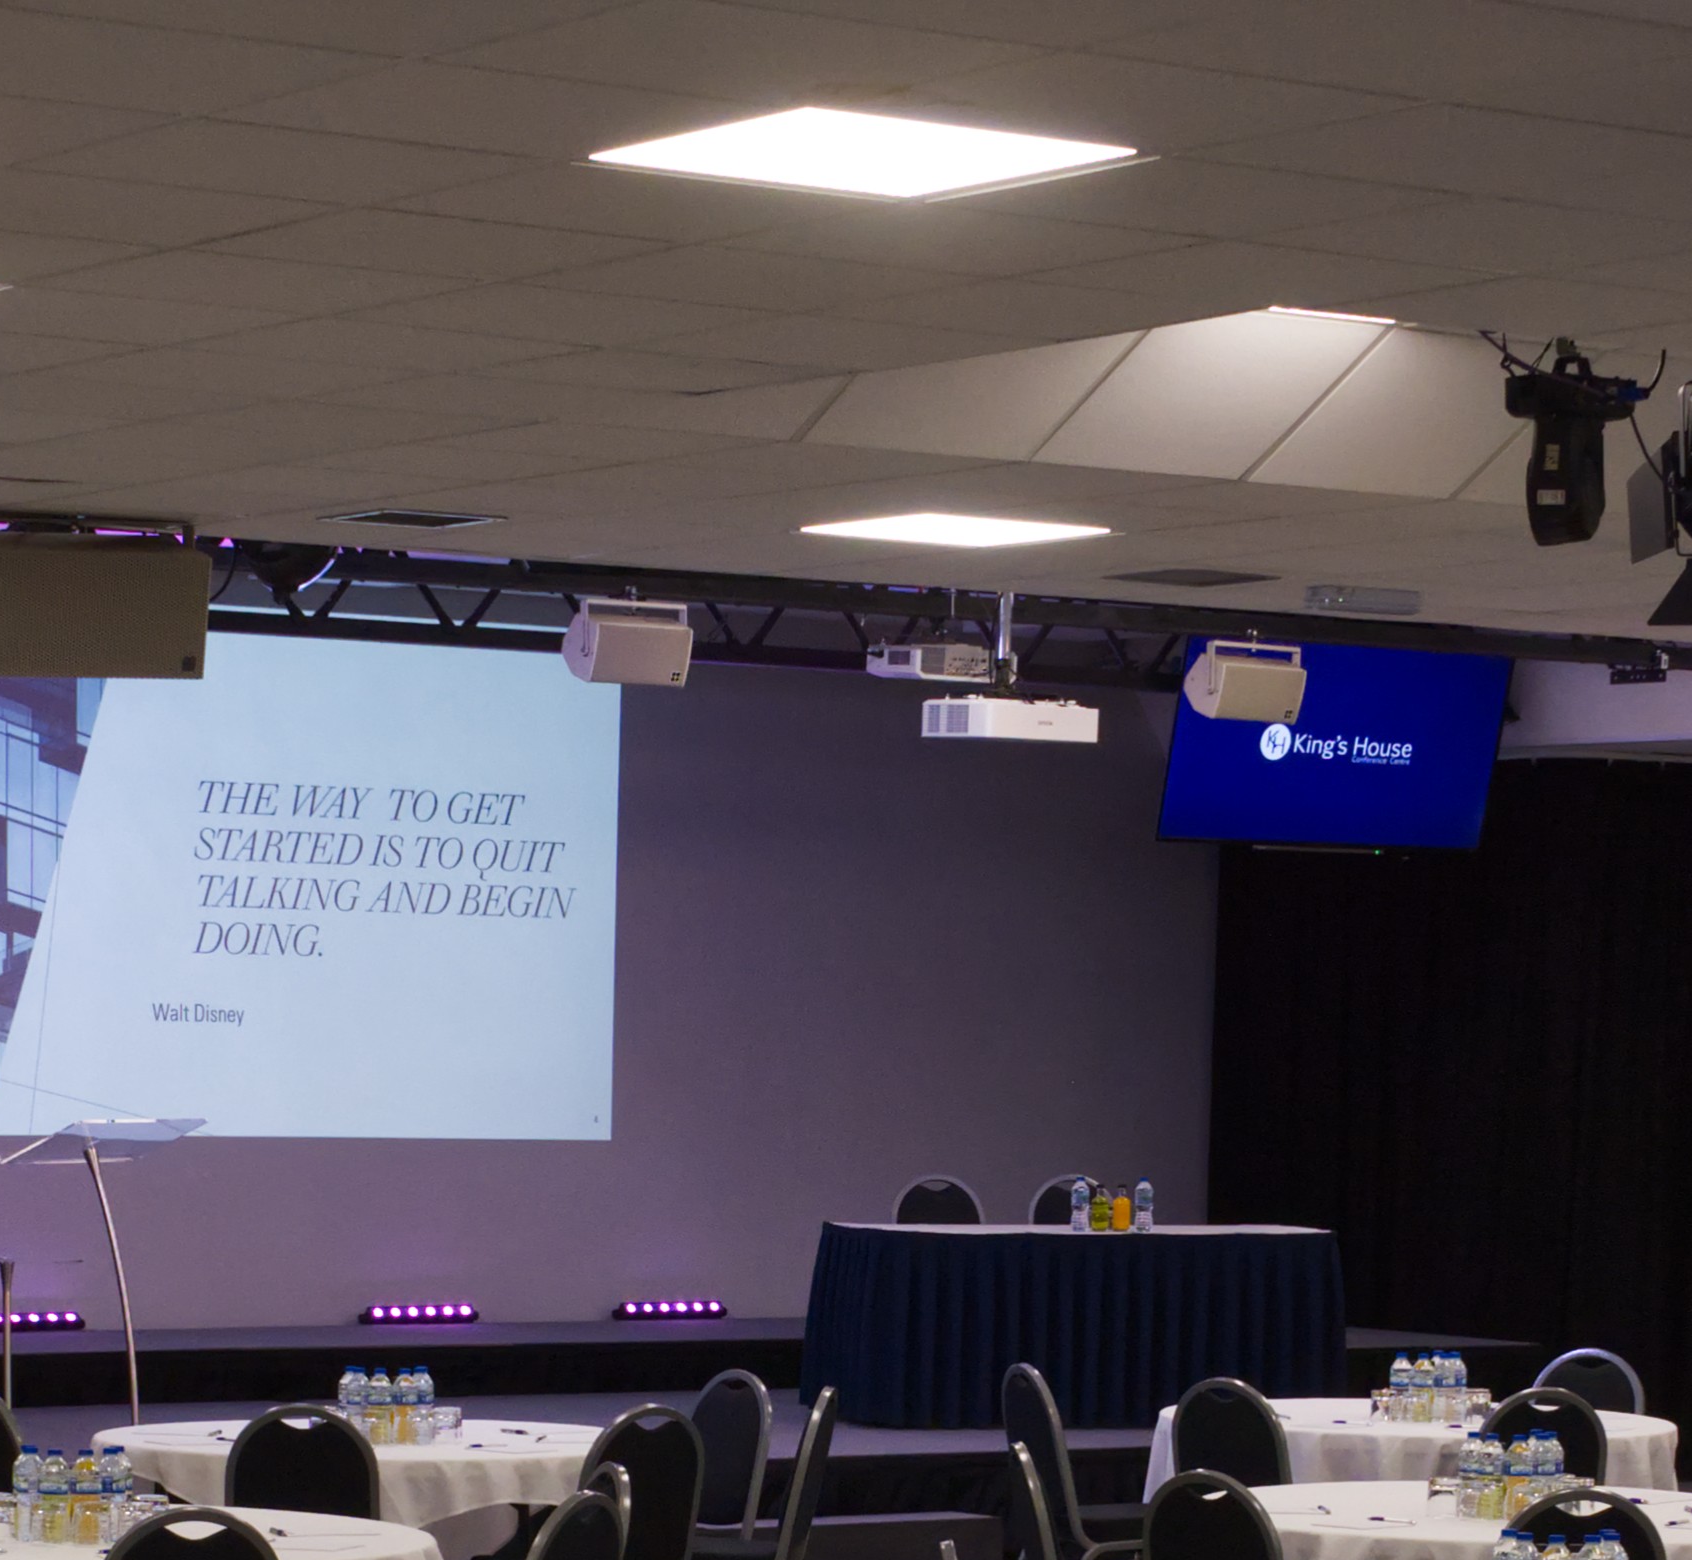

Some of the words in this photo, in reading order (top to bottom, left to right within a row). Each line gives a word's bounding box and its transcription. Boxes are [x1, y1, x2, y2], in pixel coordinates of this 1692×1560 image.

[1293, 733, 1349, 760] King's
[1353, 737, 1413, 759] House
[198, 780, 279, 817] THE
[290, 784, 374, 820] WAY
[388, 788, 439, 823] TO
[446, 790, 526, 827] GET
[194, 827, 364, 867] STARTED
[369, 834, 405, 868] IS
[414, 836, 465, 871] TO
[472, 838, 566, 881] QUIT
[197, 874, 361, 913] TALKING
[365, 881, 453, 916] AND
[456, 884, 578, 920] BEGIN
[192, 921, 324, 958] DOING.
[152, 1003, 190, 1024] Walt
[194, 1003, 245, 1028] Disney
